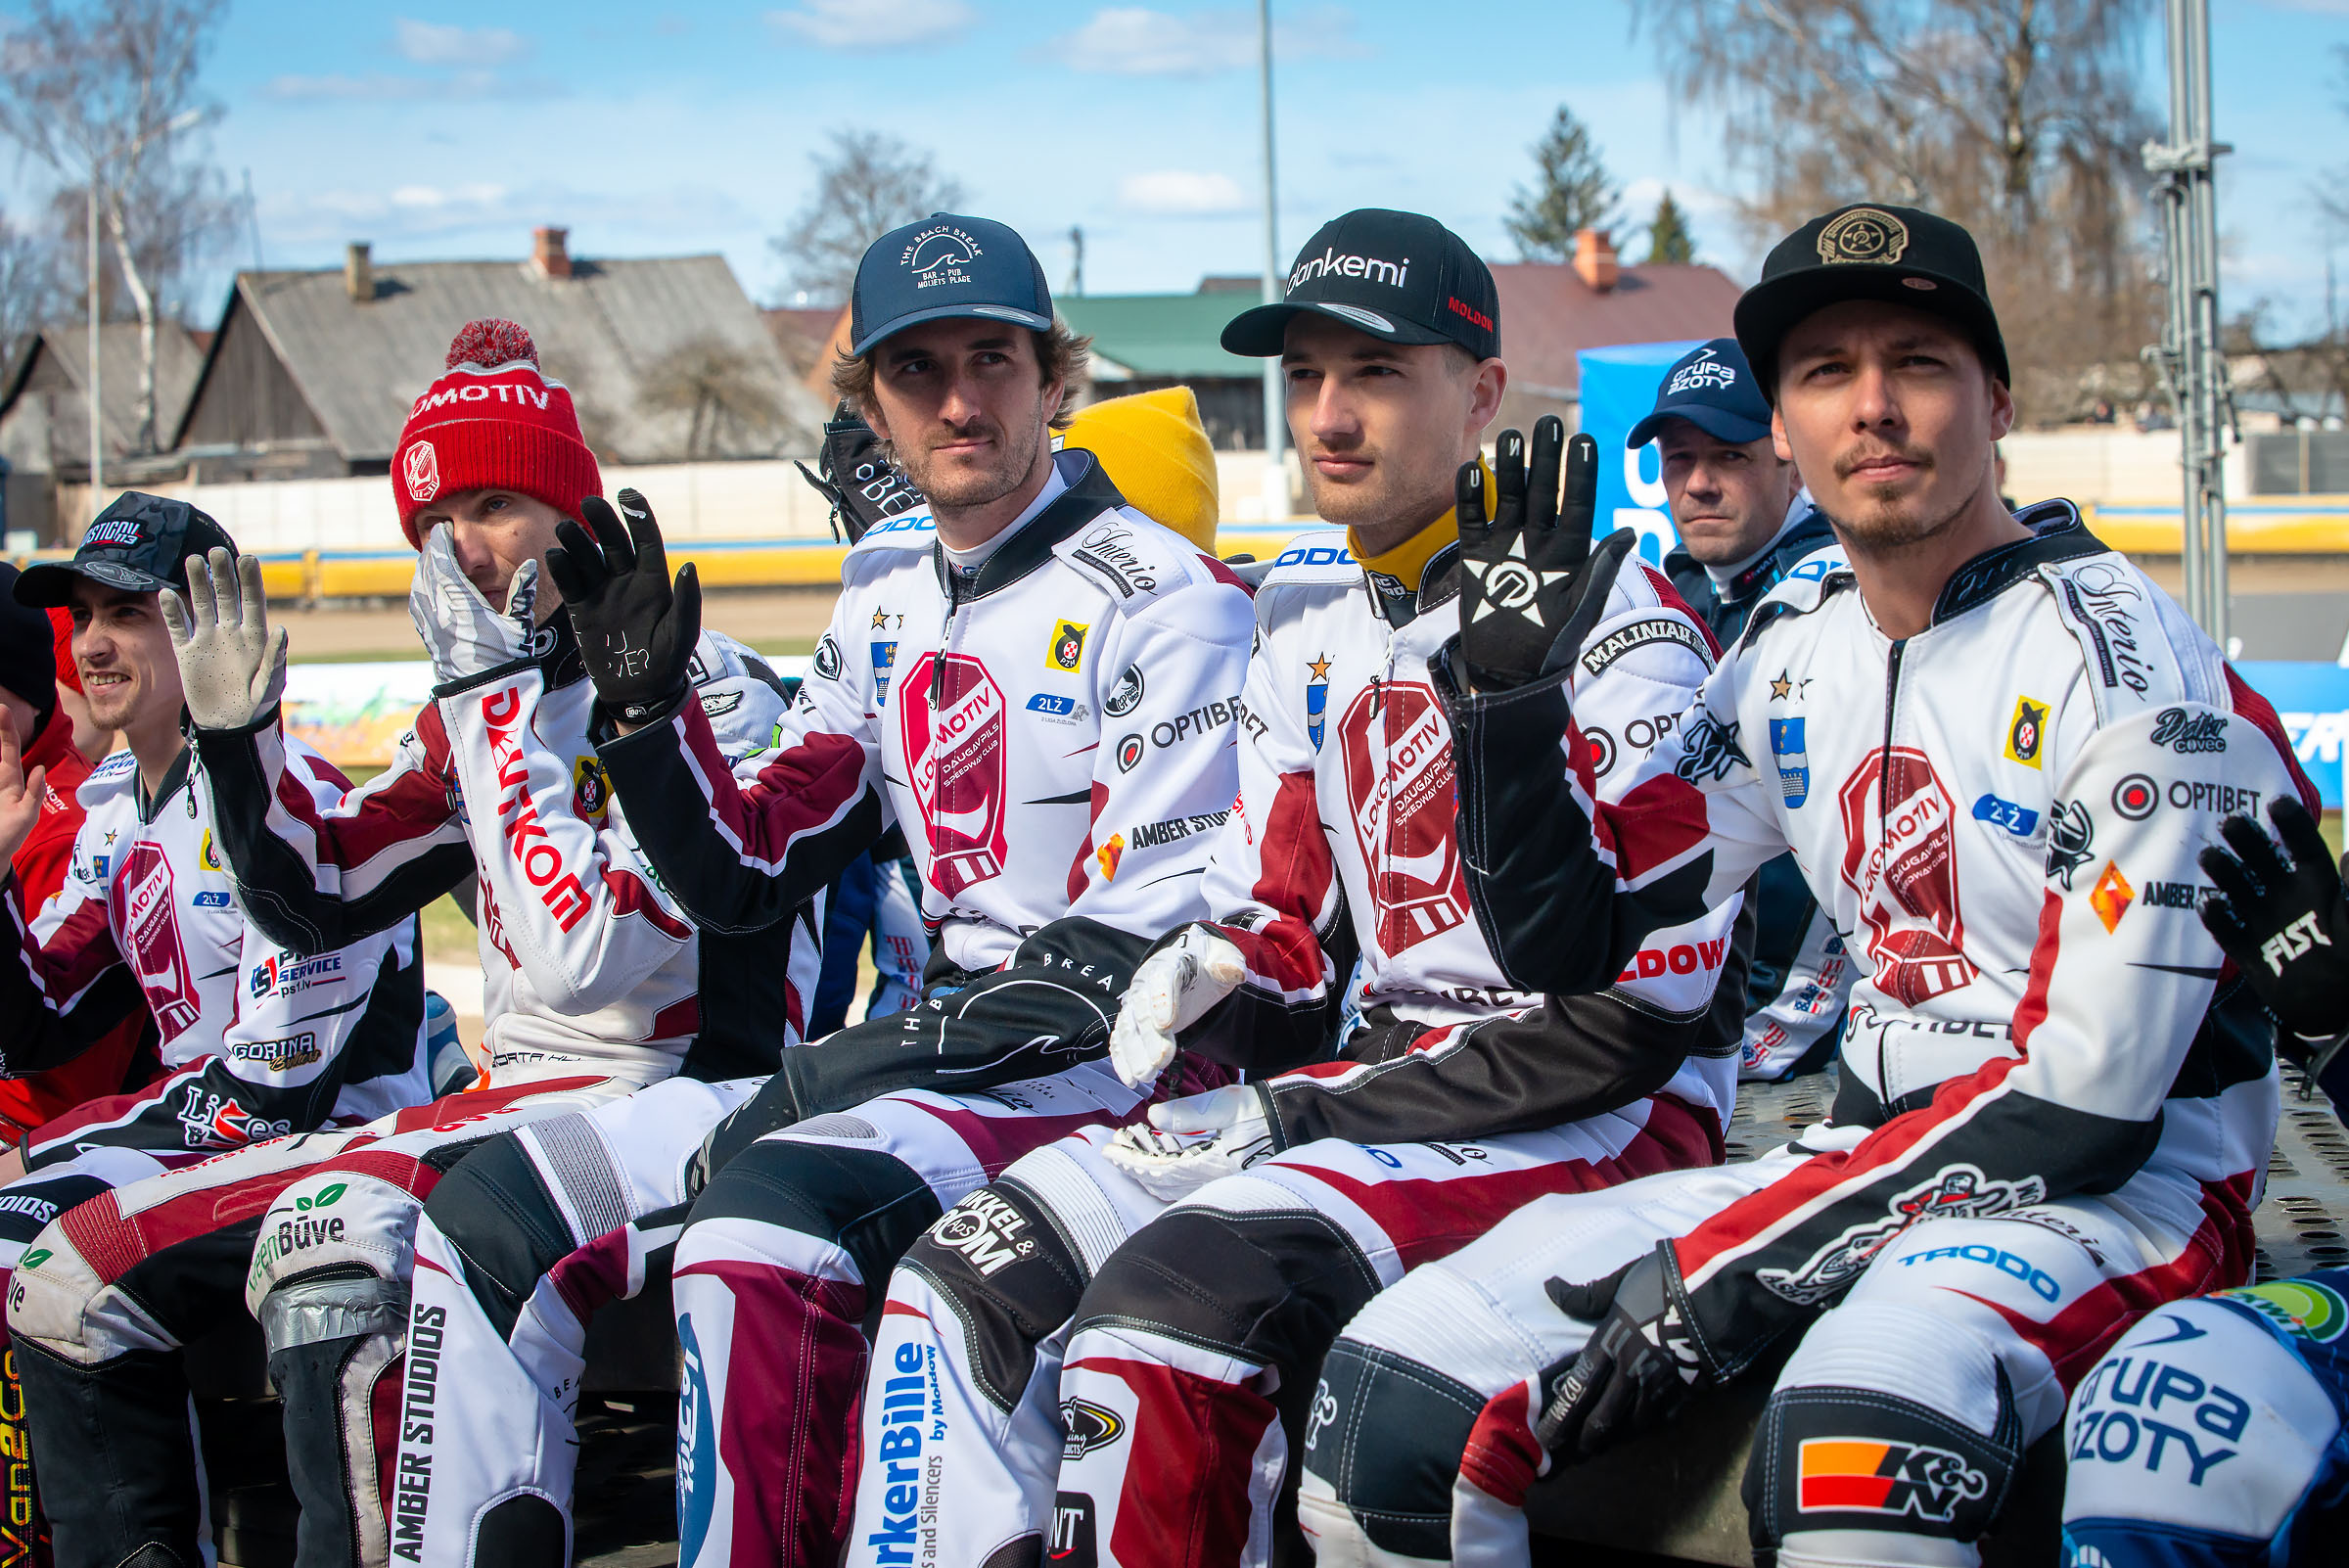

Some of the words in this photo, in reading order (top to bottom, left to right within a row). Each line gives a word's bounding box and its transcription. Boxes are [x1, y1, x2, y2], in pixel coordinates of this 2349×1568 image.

[900, 246, 914, 265] THE
[914, 226, 949, 243] BEACH
[953, 228, 983, 255] BREAK
[947, 268, 962, 277] PUB
[949, 275, 971, 284] PLAGE
[115, 532, 139, 545] 113
[1082, 523, 1158, 596] Interio
[2072, 562, 2154, 703] Interio
[1060, 657, 1076, 668] PZM
[943, 722, 999, 774] DAUGAVPILS
[944, 755, 983, 787] SPEEDWAY
[982, 739, 999, 757] CLUB
[1362, 714, 1441, 841] LOKOMOTIV
[1395, 749, 1452, 813] DAUGAVPILS
[2169, 780, 2261, 819] OPTIBET
[1395, 780, 1437, 827] SPEEDWAY
[1132, 818, 1192, 851] AMBER
[2142, 882, 2195, 910] AMBER
[137, 895, 169, 945] DAUGAVPILS
[2260, 909, 2332, 979] FIST
[278, 955, 342, 984] SERVICE
[281, 979, 311, 998] ps1.lv
[402, 1303, 446, 1445] STUDIOS
[924, 1345, 946, 1411] Moldow
[929, 1419, 948, 1442] by
[867, 1342, 924, 1568] rkerBille
[393, 1452, 433, 1564] AMBER
[920, 1454, 943, 1524] Silencers
[921, 1529, 938, 1554] and
